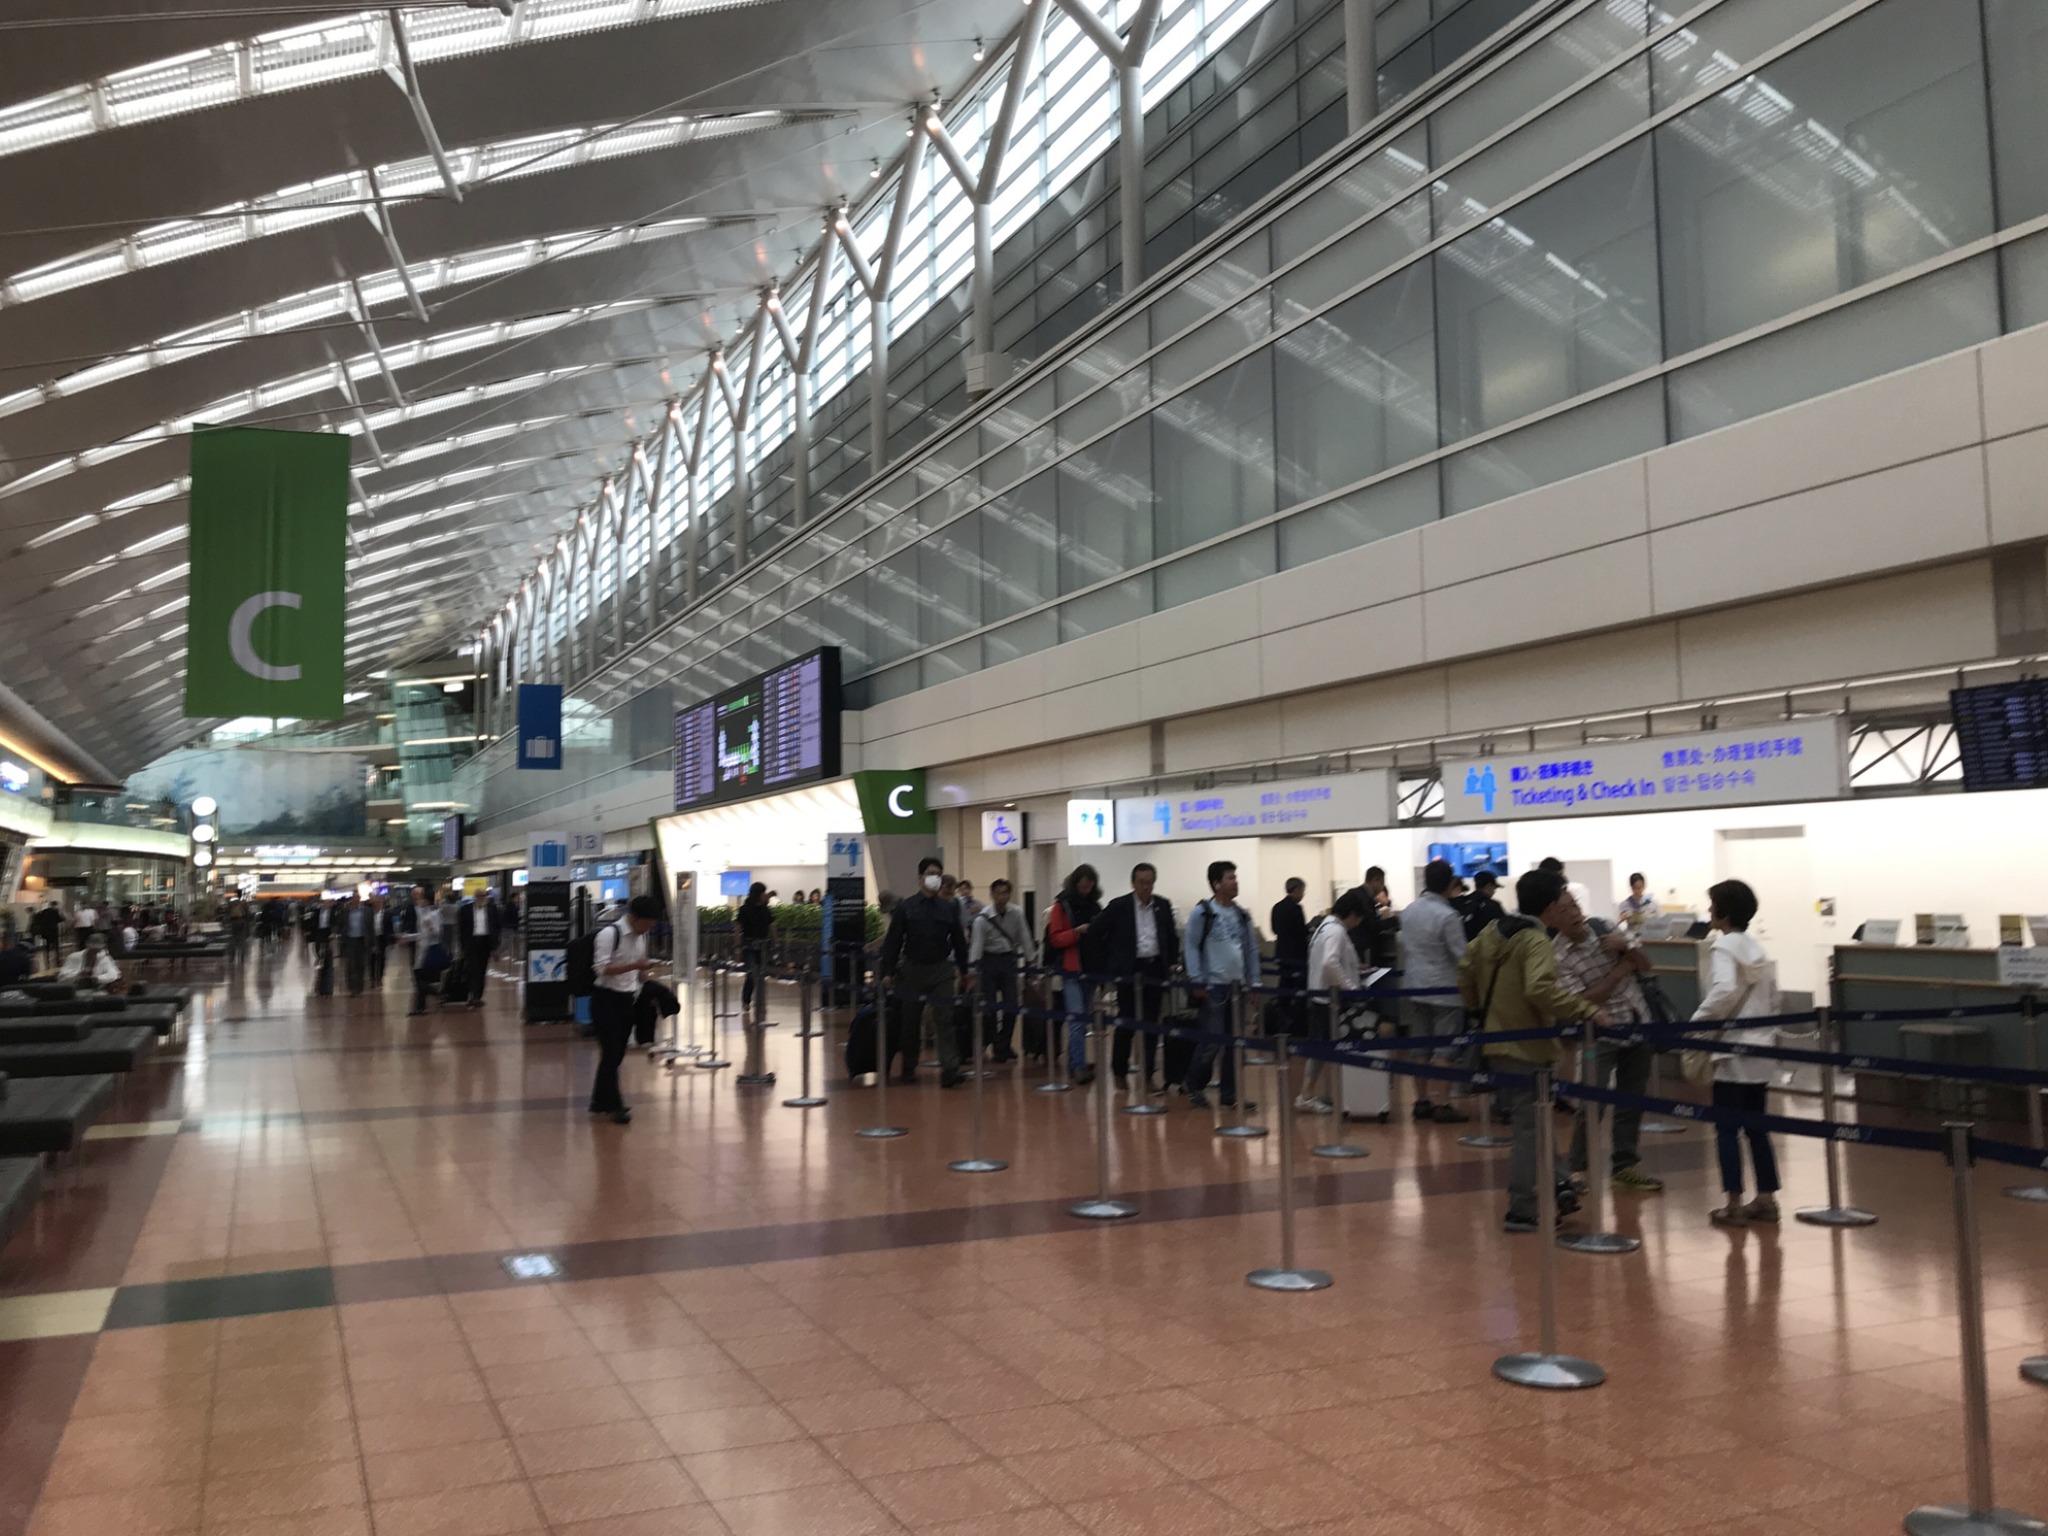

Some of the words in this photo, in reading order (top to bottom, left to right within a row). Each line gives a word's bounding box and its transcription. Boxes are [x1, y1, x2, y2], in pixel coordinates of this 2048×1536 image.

[228, 590, 303, 682] C
[888, 784, 913, 817] C
[1511, 786, 1574, 807] Ticketing
[1577, 782, 1588, 801] &
[1591, 777, 1637, 800] Check
[1640, 777, 1656, 797] In
[574, 835, 598, 849] 13
